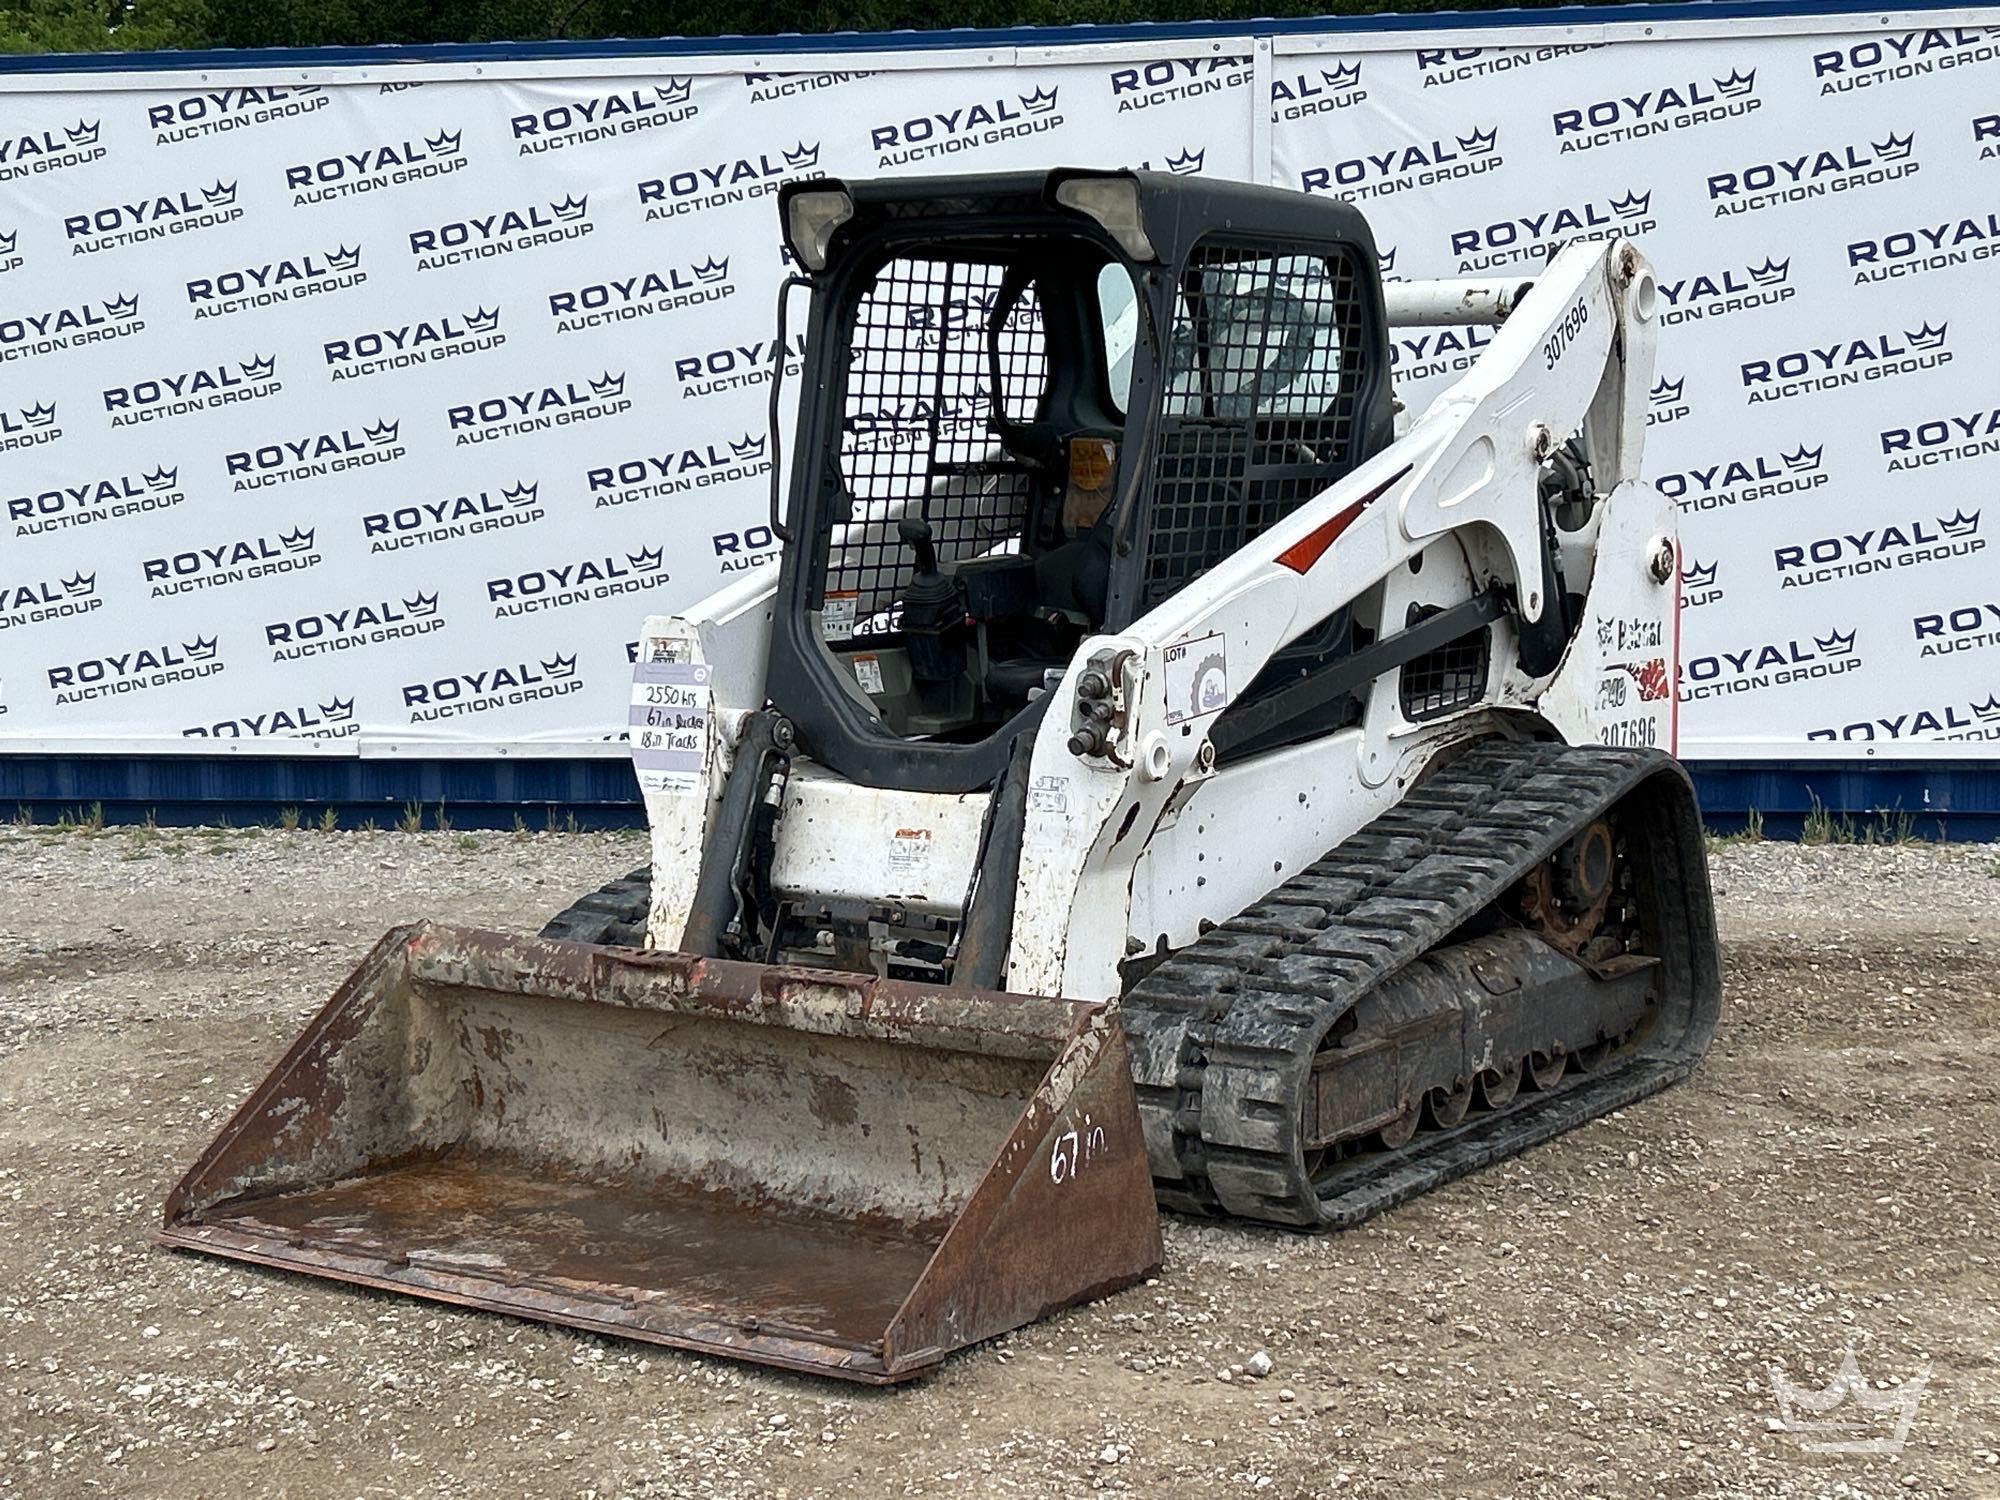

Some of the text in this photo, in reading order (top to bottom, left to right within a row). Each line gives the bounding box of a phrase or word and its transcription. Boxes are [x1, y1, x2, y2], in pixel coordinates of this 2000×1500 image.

[1424, 52, 1530, 88] AUCTION
[1821, 60, 1933, 96] AUCTION
[511, 91, 656, 138] ROYAL
[1118, 78, 1221, 113] AUCTION
[1285, 91, 1367, 120] GROUP
[1553, 83, 1714, 135] ROYAL
[157, 97, 329, 146] AUCTION GROUP
[520, 106, 698, 156] AUCTION GROUP
[871, 100, 1020, 150] ROYAL
[879, 116, 1063, 168] AUCTION GROUP
[1560, 99, 1761, 154] AUCTION GROUP
[33, 148, 106, 173] GROUP
[286, 142, 426, 189] ROYAL
[294, 158, 467, 207] AUCTION GROUP
[638, 155, 784, 204] ROYAL
[1301, 141, 1457, 193] ROYAL
[1334, 157, 1503, 203] CTION GROUP
[1707, 146, 1872, 199] ROYAL
[646, 190, 743, 221] AUCTION
[1715, 163, 1919, 218] AUCTION GROUP
[65, 192, 203, 239] ROYAL
[73, 208, 243, 256] AUCTION GROUP
[409, 207, 552, 254] ROYAL
[1451, 204, 1610, 256] ROYAL
[418, 223, 593, 271] AUCTION GROUP
[1854, 251, 1967, 285] AUCTION
[187, 257, 326, 303] ROYAL
[195, 273, 367, 320] AUCTION GROUP
[549, 269, 693, 315] ROYAL
[1708, 288, 1795, 315] GROUP
[557, 285, 734, 333] AUCTION GROUP
[0, 321, 145, 362] CTION GROUP
[324, 318, 464, 364] ROYAL
[1544, 296, 1588, 370] 307696
[332, 335, 506, 381] AUCTION GROUP
[1741, 335, 1905, 386] ROYAL
[1748, 352, 1952, 405] AUCTION GROUP
[103, 366, 241, 411] ROYAL
[112, 383, 282, 428] AUCTION GROUP
[448, 384, 590, 429] ROYAL
[456, 400, 631, 446] AUCTION GROUP
[226, 431, 365, 475] ROYAL
[234, 447, 405, 492] AUCTION GROUP
[587, 446, 730, 491] ROYAL
[1888, 439, 1999, 472] AUCTION
[8, 477, 144, 520] ROYAL
[596, 462, 772, 508] AUCTION GROUP
[1742, 474, 1828, 501] GROUP
[16, 493, 184, 537] AUCTION GROUP
[363, 493, 503, 537] ROYAL
[372, 509, 544, 554] AUCTION GROUP
[143, 538, 281, 581] ROYAL
[1775, 522, 1938, 571] ROYAL
[1782, 539, 1985, 589] AUCTION GROUP
[152, 554, 321, 598] AUCTION GROUP
[487, 558, 628, 601] ROYAL
[496, 574, 669, 618] AUCTION GROUP
[30, 599, 102, 622] GROUP
[265, 603, 404, 645] ROYAL
[274, 619, 445, 662] AUCTION GROUP
[48, 646, 184, 689] ROYAL
[56, 663, 224, 705] AUCTION GROUP
[402, 664, 542, 707] ROYAL
[1775, 659, 1861, 684] GROUP
[411, 681, 583, 723] AUCTION GROUP
[647, 686, 679, 704] 2550
